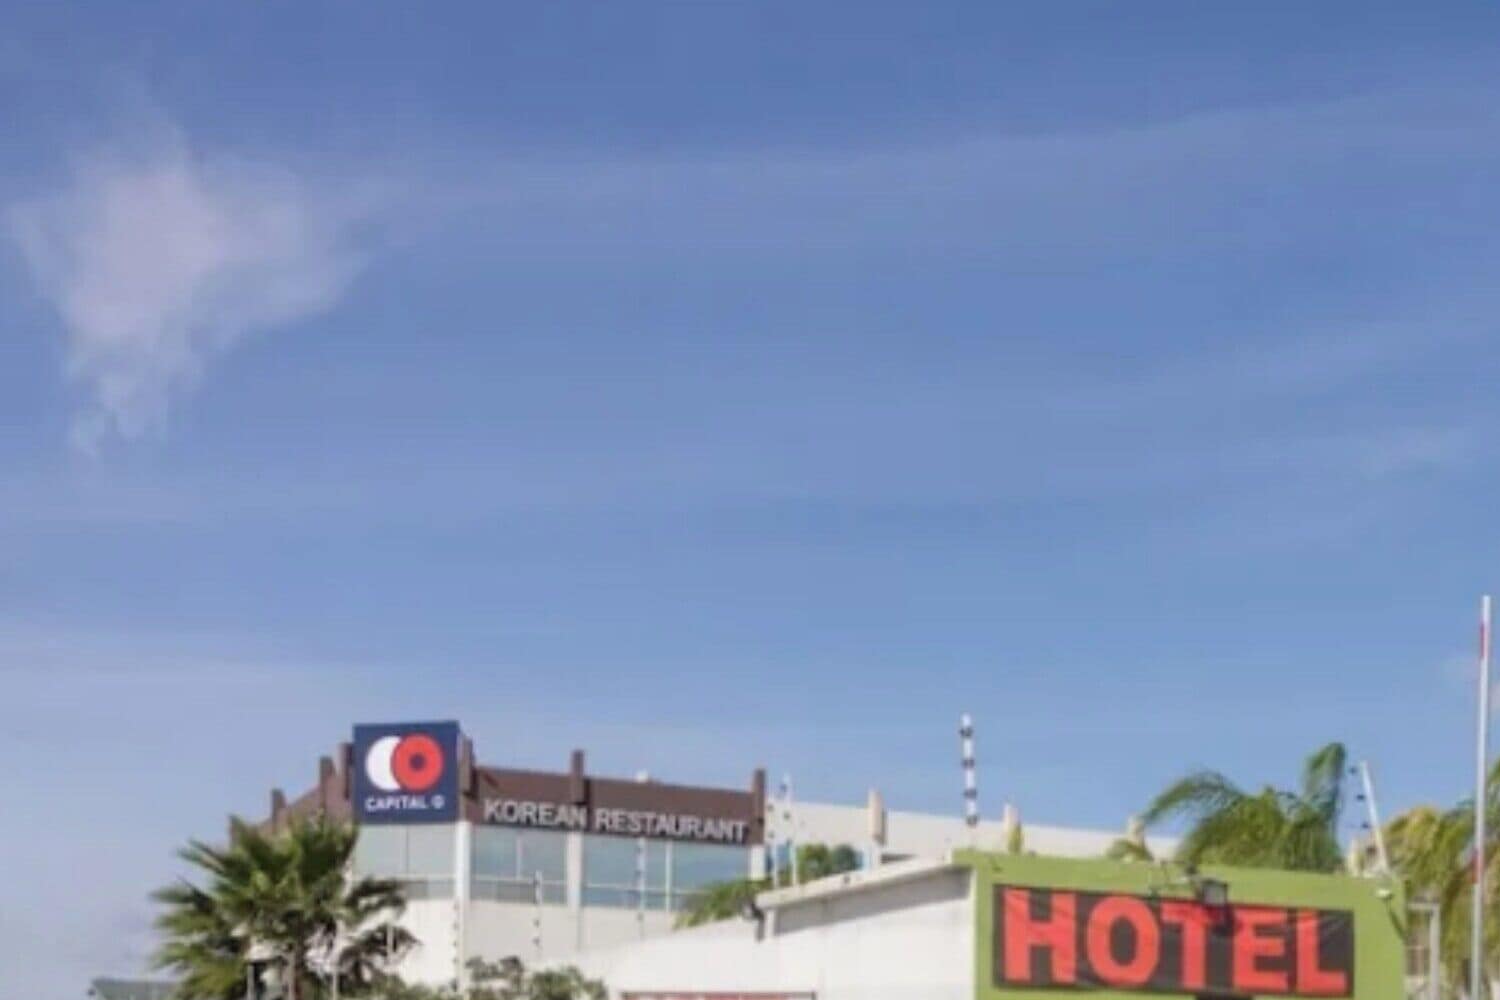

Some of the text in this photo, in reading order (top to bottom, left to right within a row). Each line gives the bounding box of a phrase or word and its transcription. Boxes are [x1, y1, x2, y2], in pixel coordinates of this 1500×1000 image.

[365, 795, 427, 811] CAPITAL
[484, 801, 748, 840] KOREAN RESTAURANT
[1003, 888, 1347, 993] HOTEL
